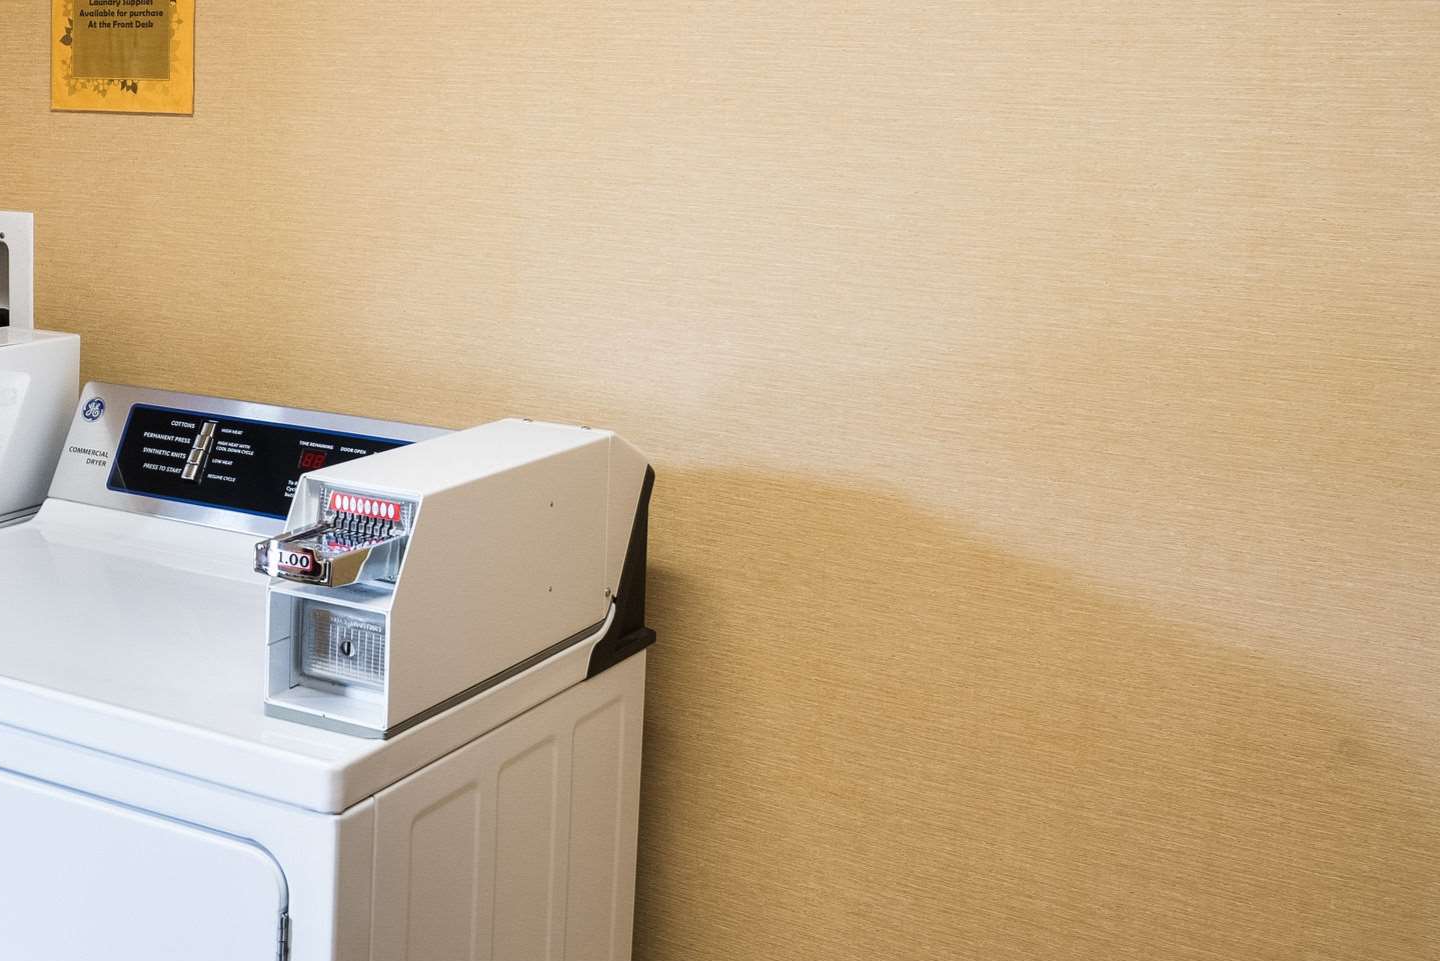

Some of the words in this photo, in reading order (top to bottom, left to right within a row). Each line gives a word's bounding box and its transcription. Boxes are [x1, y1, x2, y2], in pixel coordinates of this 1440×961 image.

[80, 9, 115, 17] Available
[116, 9, 127, 17] for
[129, 9, 163, 18] purchase
[113, 21, 133, 29] Front
[135, 21, 154, 29] Desk
[84, 400, 103, 419] GE
[171, 420, 195, 429] COTTONS
[143, 431, 174, 442] PERMANENT
[175, 435, 191, 444] PRESS
[309, 442, 334, 450] REMAINING
[68, 446, 109, 458] COMMERCIAL
[143, 447, 170, 457] SYNTHETIC
[171, 451, 187, 459] KNITS
[86, 458, 107, 467] DRYER
[143, 462, 159, 471] PRESS
[166, 466, 182, 474] START
